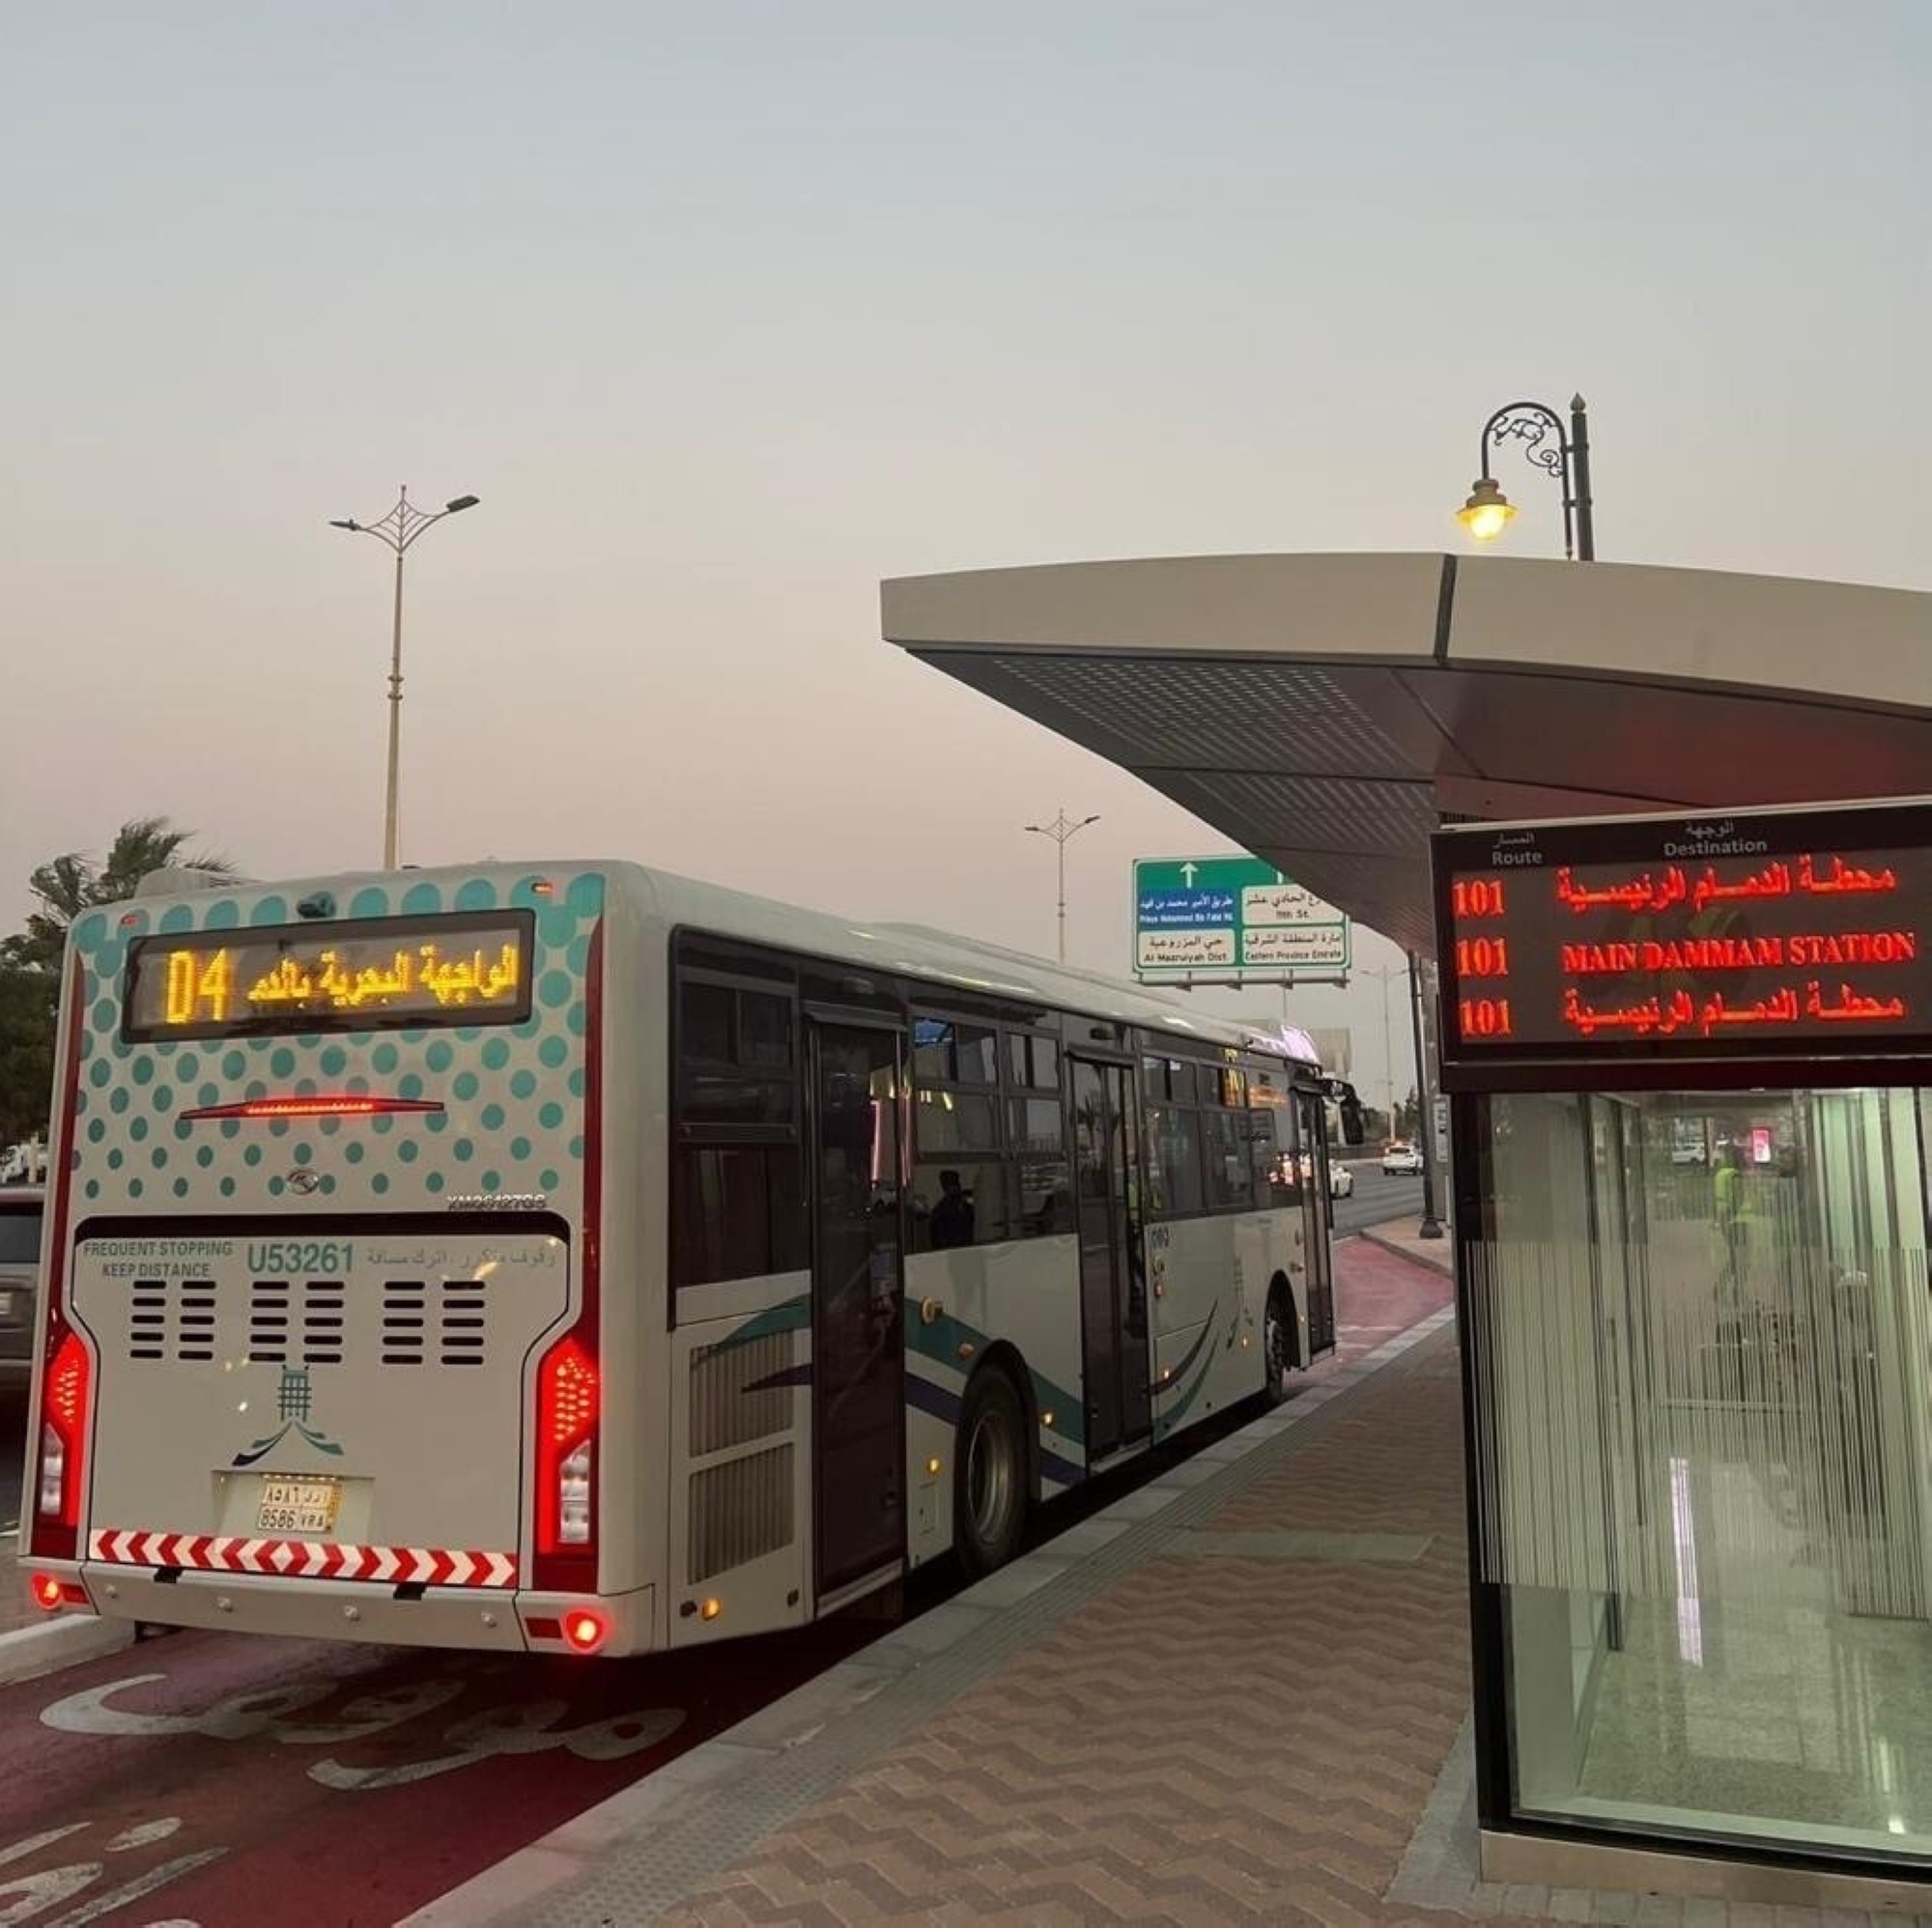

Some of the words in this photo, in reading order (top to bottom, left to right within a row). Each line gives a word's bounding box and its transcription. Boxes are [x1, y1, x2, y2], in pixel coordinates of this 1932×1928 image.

[1492, 832, 1535, 848] المسار
[1663, 837, 1768, 857] Destination
[1686, 820, 1735, 838] الوجهة
[1492, 850, 1543, 865] Route
[1798, 854, 1896, 894] محطة
[1453, 880, 1506, 918] 101
[1693, 861, 1790, 914] الدمام
[1457, 937, 1509, 977] 101
[1561, 940, 1638, 974] MAIN
[1643, 935, 1784, 972] DAMMAM
[1789, 930, 1917, 967] STATION
[320, 950, 409, 1006] البحرية
[419, 945, 519, 1005] الواجهة
[1461, 999, 1514, 1036] 101
[1700, 987, 1798, 1037] الدمام
[1806, 979, 1904, 1020] محطة
[83, 1242, 157, 1257] FREQUENT
[158, 1240, 234, 1256] STOPPING
[247, 1242, 354, 1274] U53261
[101, 1263, 135, 1277] KEEP
[138, 1263, 211, 1278] DISTANCE
